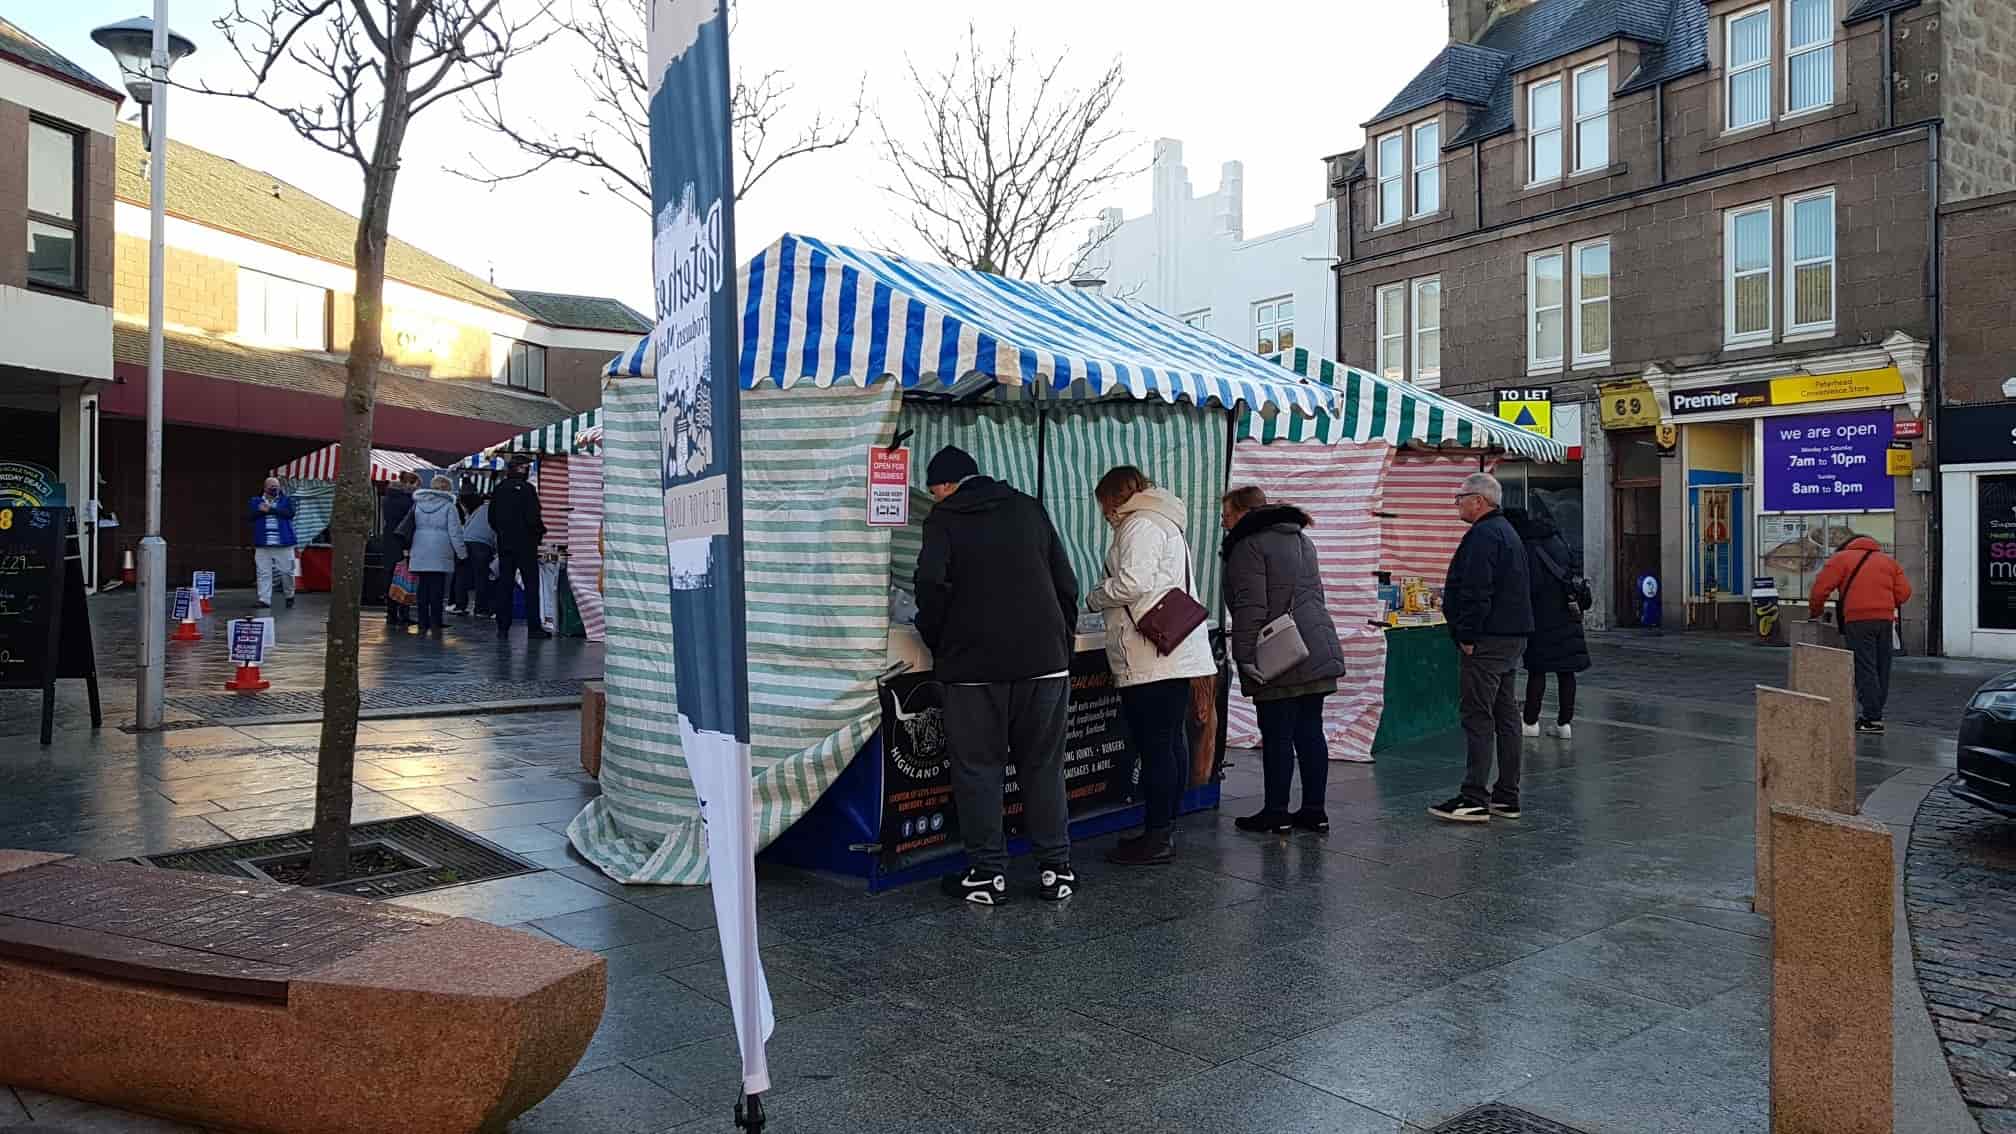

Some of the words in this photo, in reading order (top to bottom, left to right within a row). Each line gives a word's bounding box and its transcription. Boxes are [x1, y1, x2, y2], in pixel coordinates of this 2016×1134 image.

[1499, 389, 1520, 401] TO
[1524, 389, 1550, 401] LET
[1673, 390, 1739, 410] Premier
[1615, 397, 1641, 416] 69
[1779, 429, 1802, 441] we
[1807, 426, 1832, 439] are
[1836, 424, 1877, 441] open
[873, 462, 891, 470] OPEN
[1788, 455, 1816, 467] 7am
[1818, 458, 1828, 466] to
[1830, 452, 1867, 468] 10pm
[1791, 482, 1820, 494] 8am
[1822, 485, 1832, 493] to
[1834, 480, 1863, 496] 8pm
[889, 745, 941, 779] HIGHLAND
